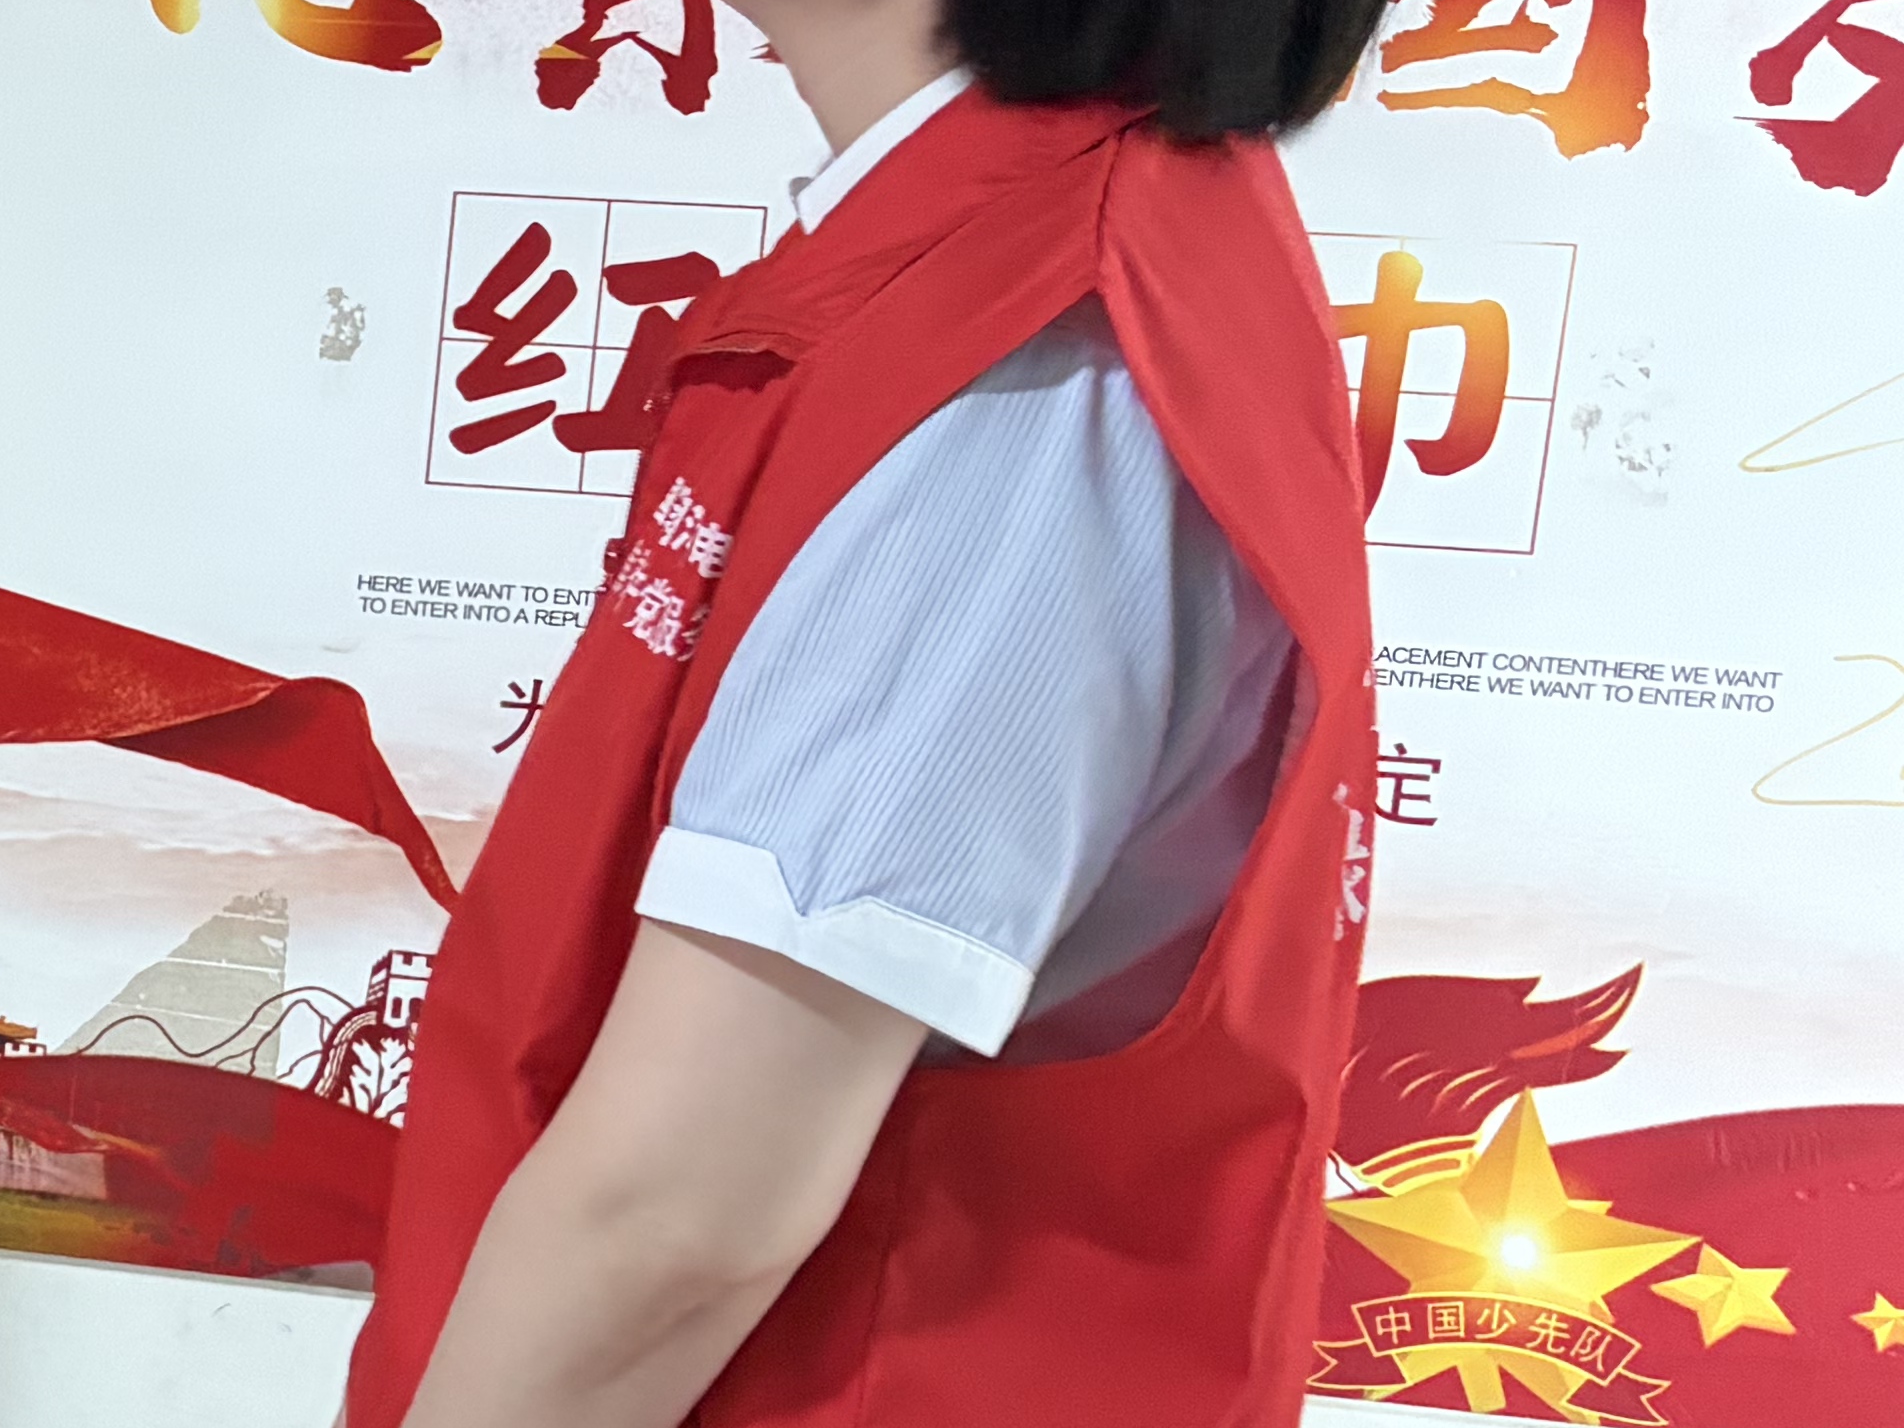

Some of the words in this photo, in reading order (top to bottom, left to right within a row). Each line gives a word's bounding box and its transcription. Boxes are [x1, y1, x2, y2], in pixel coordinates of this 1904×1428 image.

[357, 574, 413, 594] HERE
[418, 579, 451, 597] WE
[456, 581, 516, 602] WANT
[521, 585, 549, 604] TO
[553, 588, 597, 606] ENT
[1374, 646, 1489, 670] ACEMENT
[1491, 653, 1666, 683] CONTENTHERE
[1671, 665, 1709, 685] WE
[1715, 668, 1783, 690] WANT
[359, 597, 387, 615] TO
[391, 599, 458, 620] ENTER
[463, 604, 510, 624] INTO
[513, 608, 530, 625] A
[534, 609, 587, 629] REPL
[1373, 668, 1481, 693] ENTHERE
[1487, 675, 1524, 696] WE
[1530, 679, 1596, 701] WANT
[1602, 684, 1633, 703] TO
[1639, 687, 1716, 709] ENTER
[1722, 692, 1775, 713] INTO
[1375, 1300, 1612, 1372] 中国少先队
